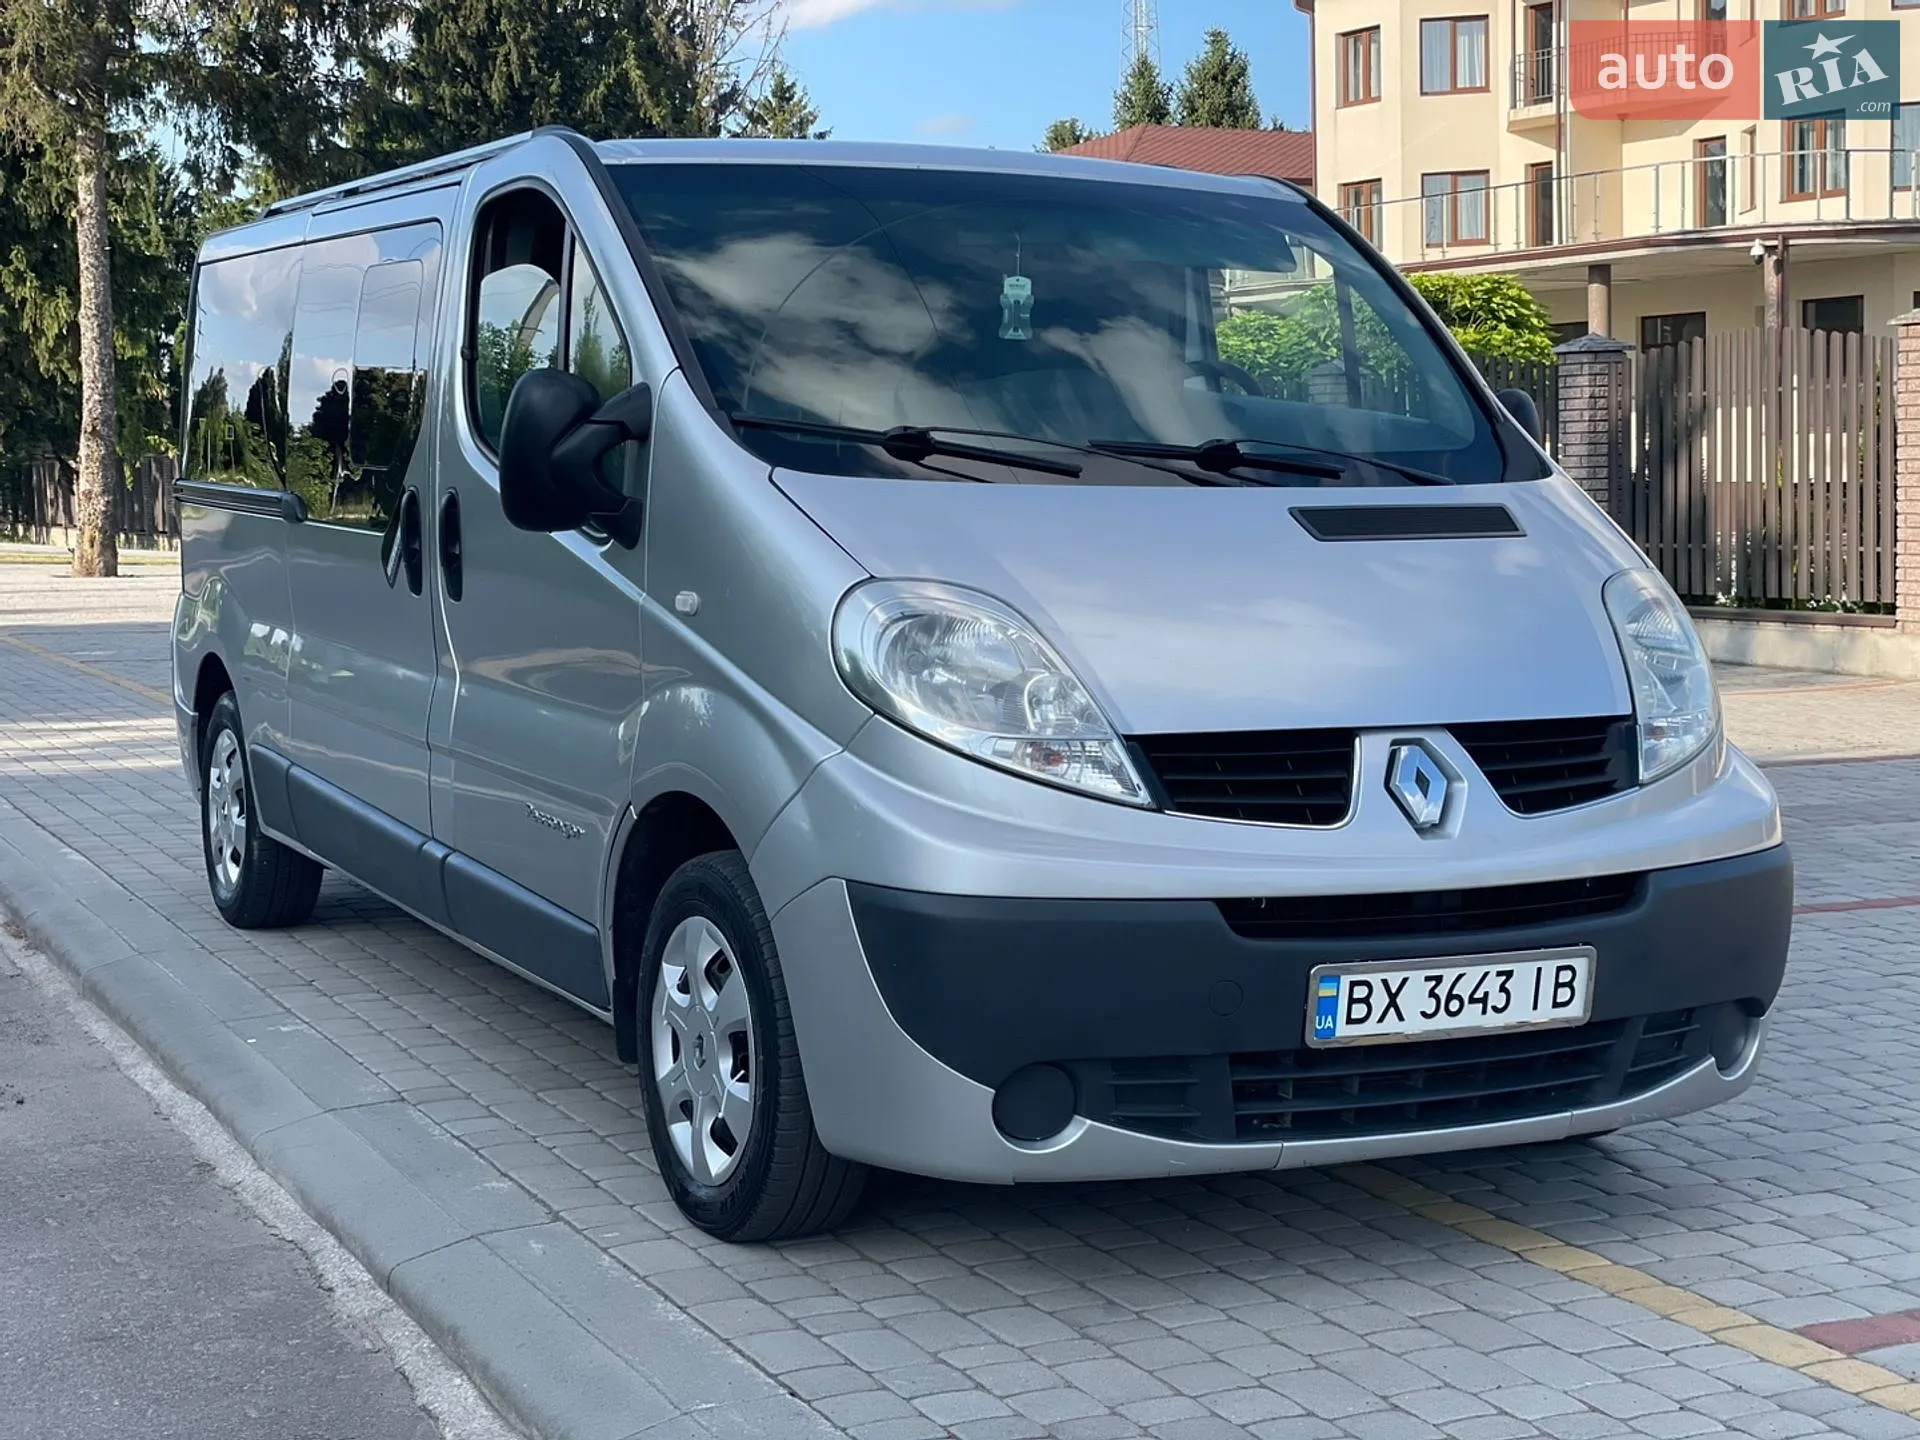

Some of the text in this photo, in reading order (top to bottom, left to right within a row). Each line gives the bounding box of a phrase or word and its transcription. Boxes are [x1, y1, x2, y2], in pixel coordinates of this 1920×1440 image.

[1345, 964, 1577, 1025] BX 3643 IB
[1315, 1015, 1334, 1030] UA
